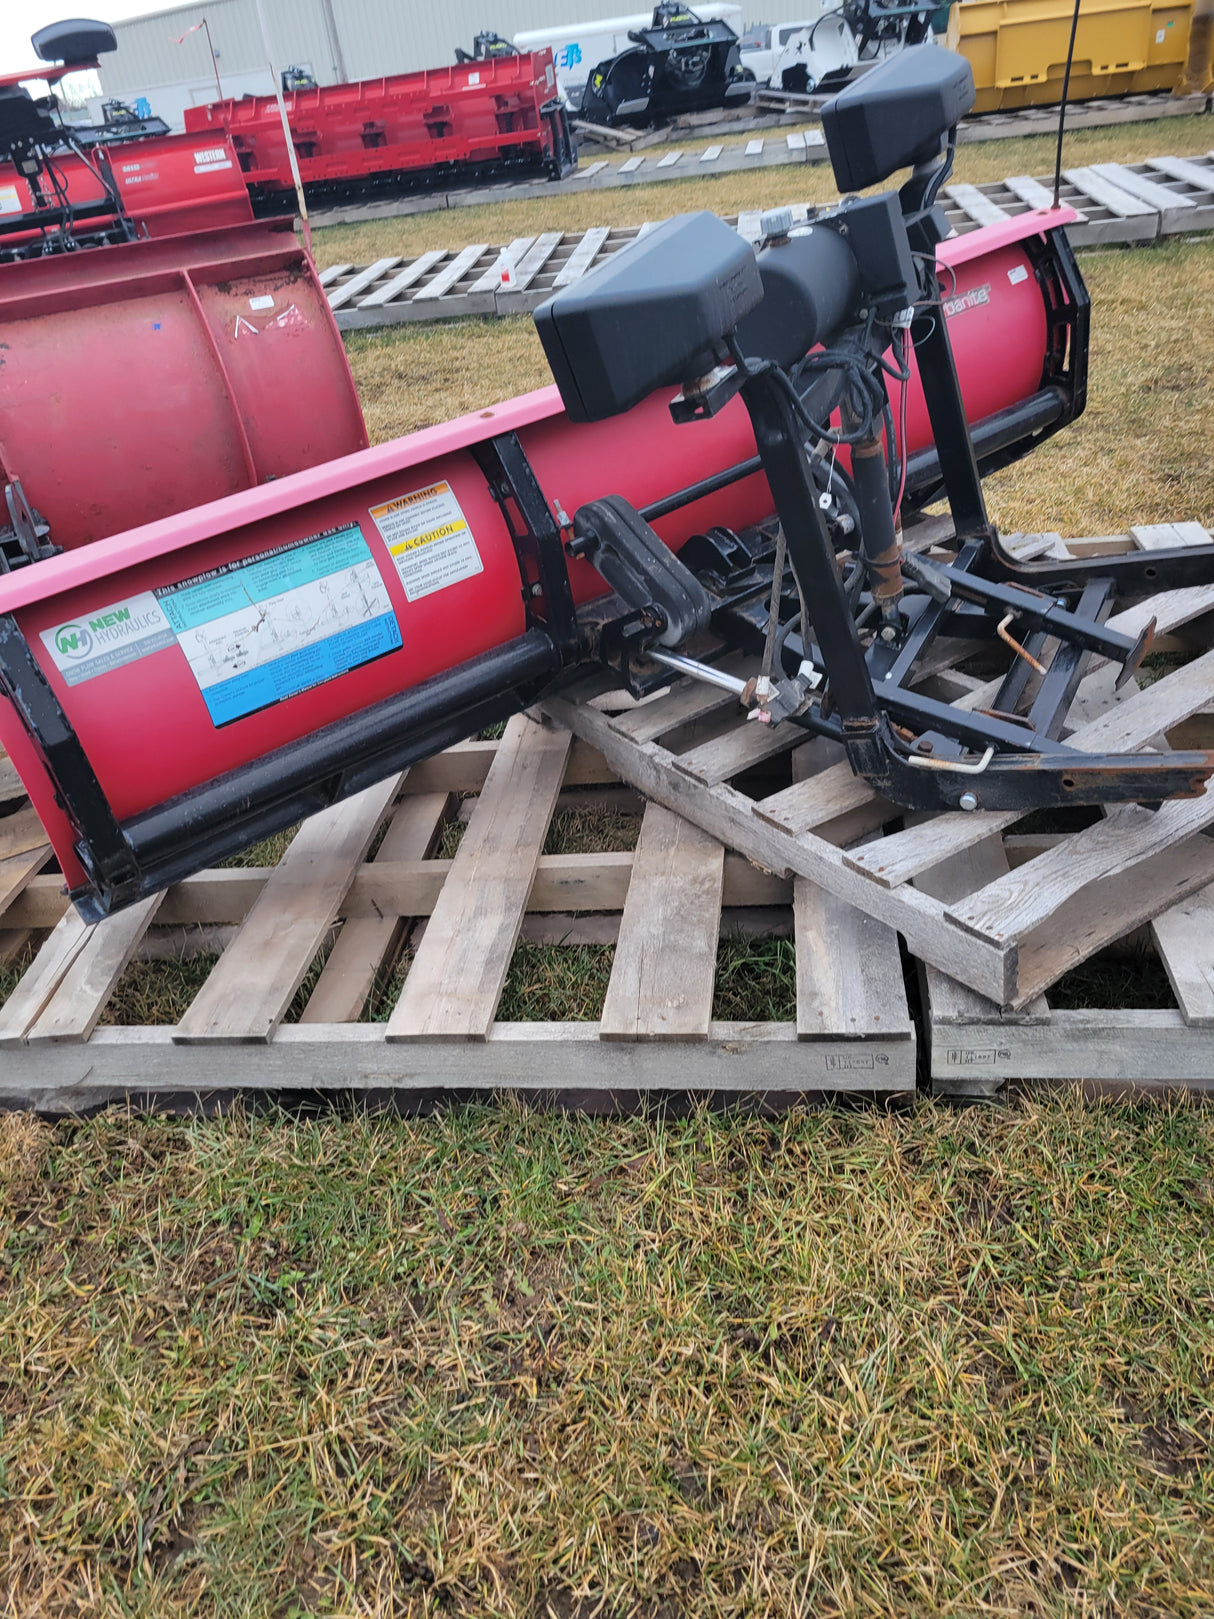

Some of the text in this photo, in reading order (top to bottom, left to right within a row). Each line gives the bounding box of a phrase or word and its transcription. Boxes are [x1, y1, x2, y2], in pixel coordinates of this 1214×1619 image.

[393, 488, 438, 510] WARNING
[413, 525, 454, 546] CAUTION
[157, 585, 176, 597] This
[176, 568, 219, 590] snowplow
[218, 564, 228, 574] is
[227, 560, 241, 571] for
[88, 607, 131, 632] NEW
[95, 610, 161, 645] HYDRAULICS
[163, 600, 182, 629] ATTACH
